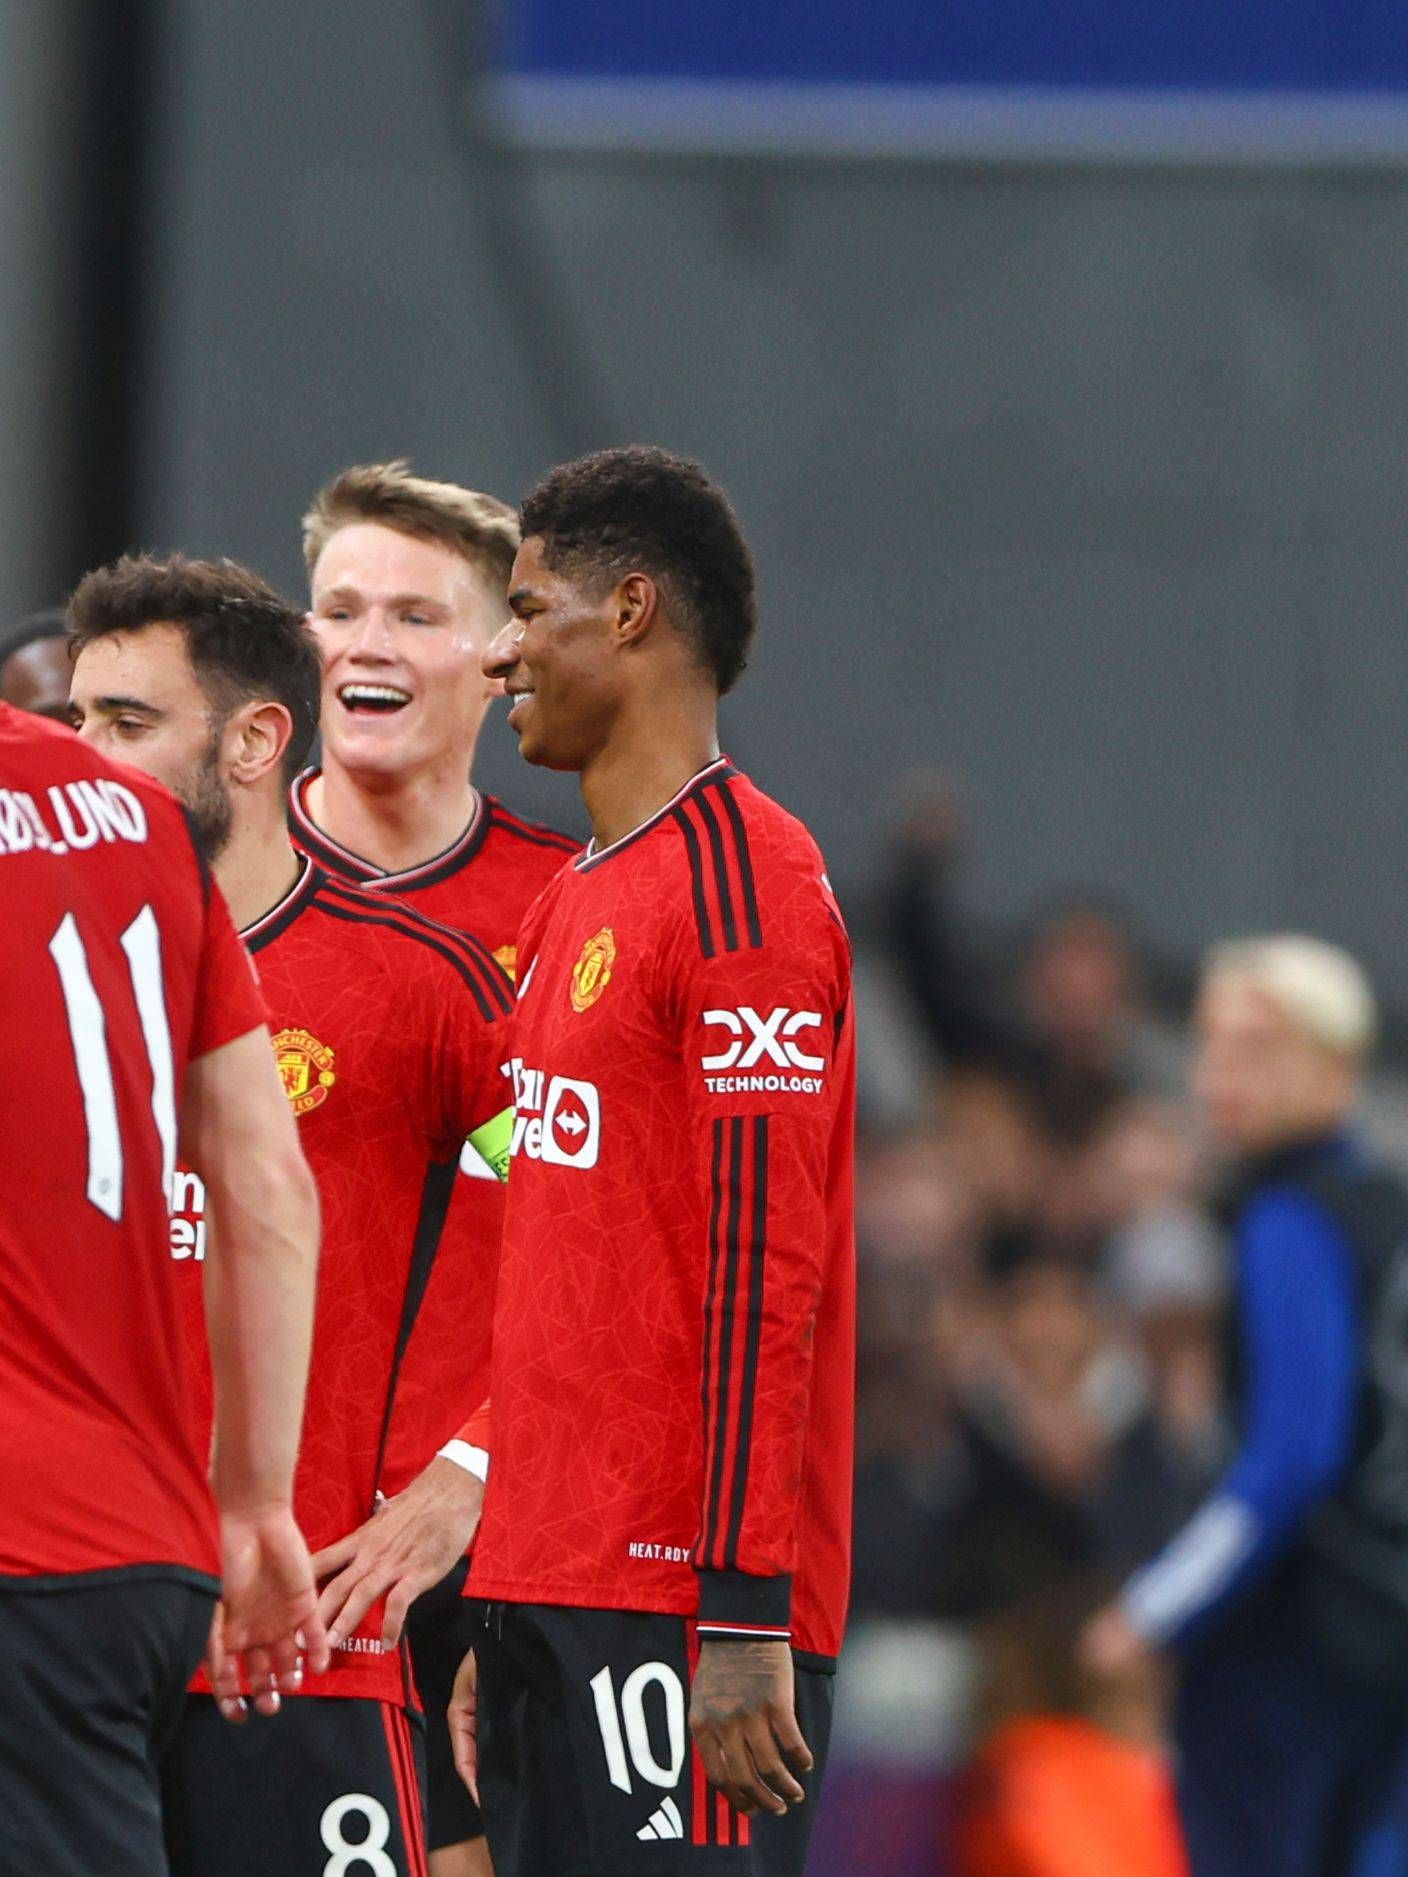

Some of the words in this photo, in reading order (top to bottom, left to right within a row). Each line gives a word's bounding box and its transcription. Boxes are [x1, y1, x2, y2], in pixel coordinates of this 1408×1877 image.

[48, 902, 178, 1223] 11
[701, 1006, 825, 1071] DXC
[703, 1075, 823, 1094] TECHNOLOGY
[628, 1542, 691, 1563] HEAT.RDY
[589, 1661, 686, 1795] 10
[319, 1792, 398, 1877] 8
